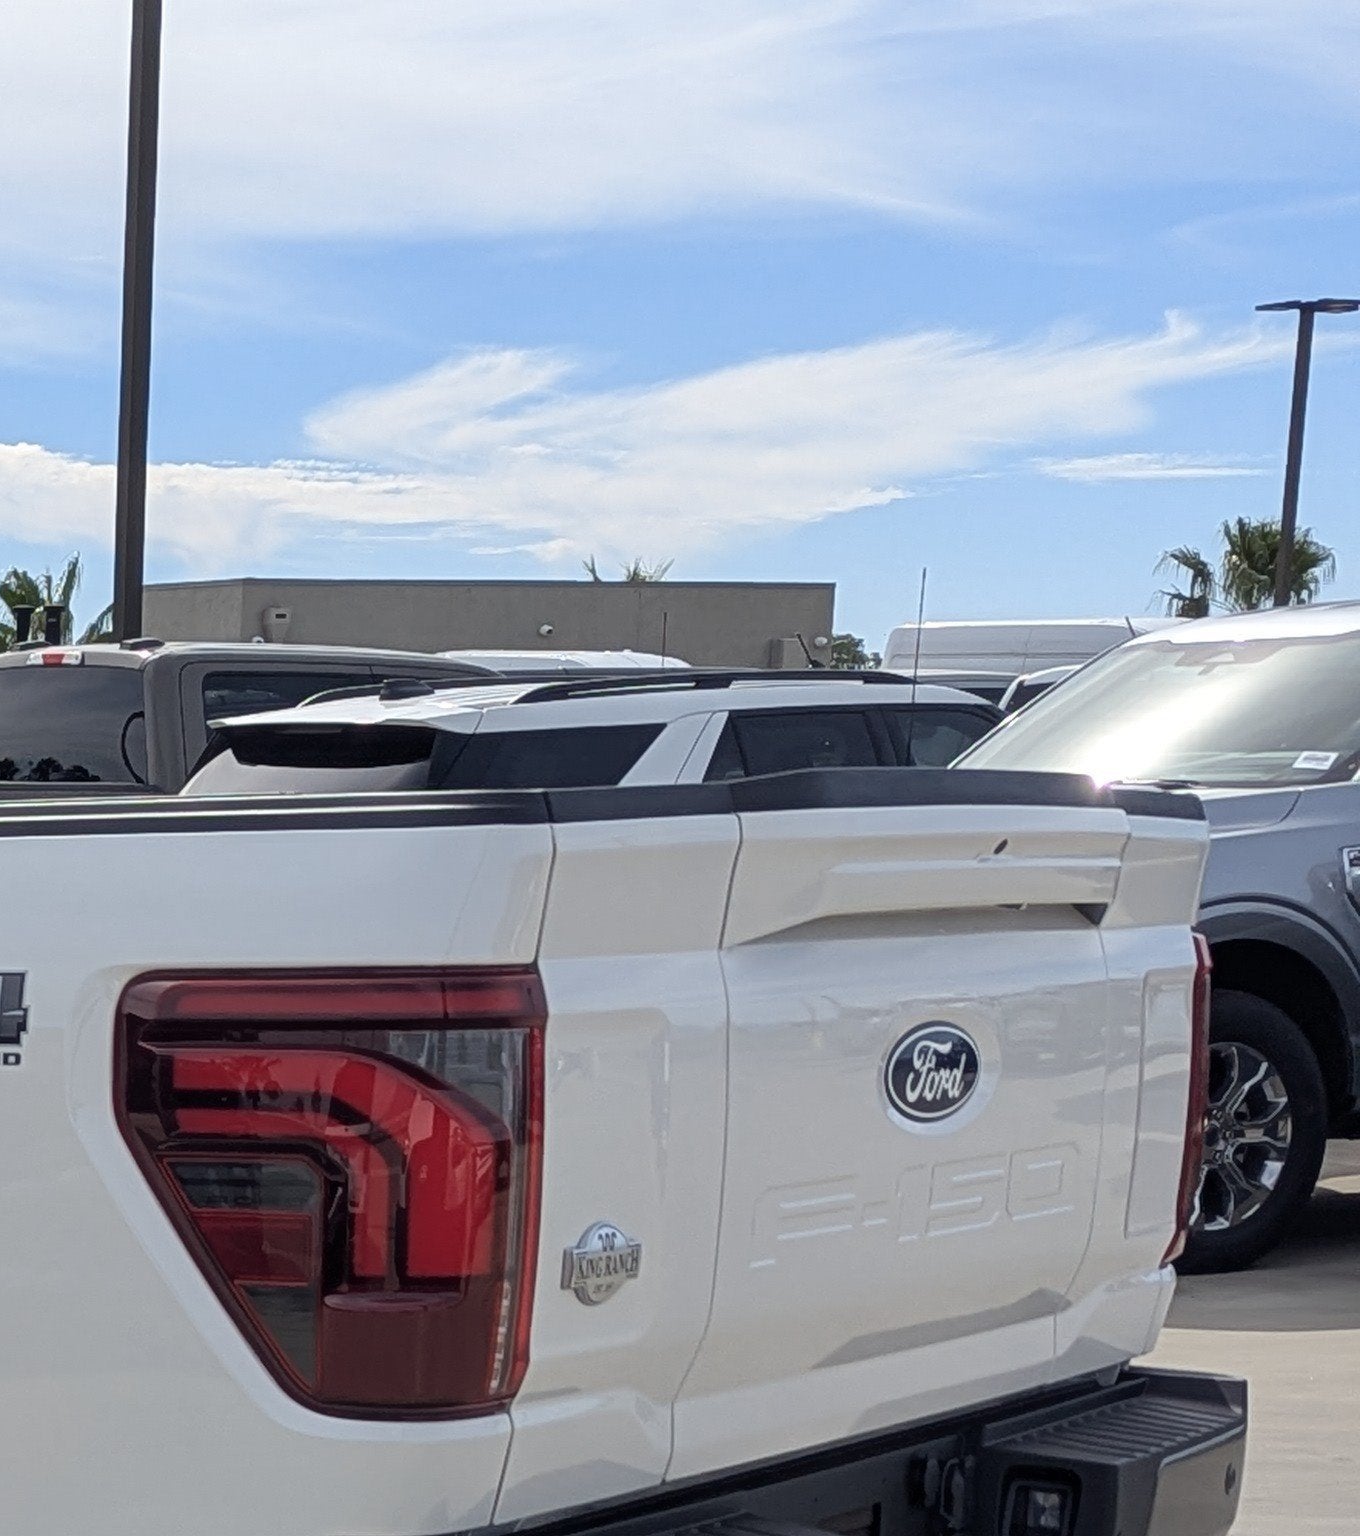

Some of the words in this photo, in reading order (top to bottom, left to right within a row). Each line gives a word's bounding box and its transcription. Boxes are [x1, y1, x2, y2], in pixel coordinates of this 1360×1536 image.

[906, 1040, 967, 1103] Ford
[749, 1141, 1081, 1268] F-150
[575, 1255, 603, 1279] KING
[604, 1248, 639, 1276] RANCH
